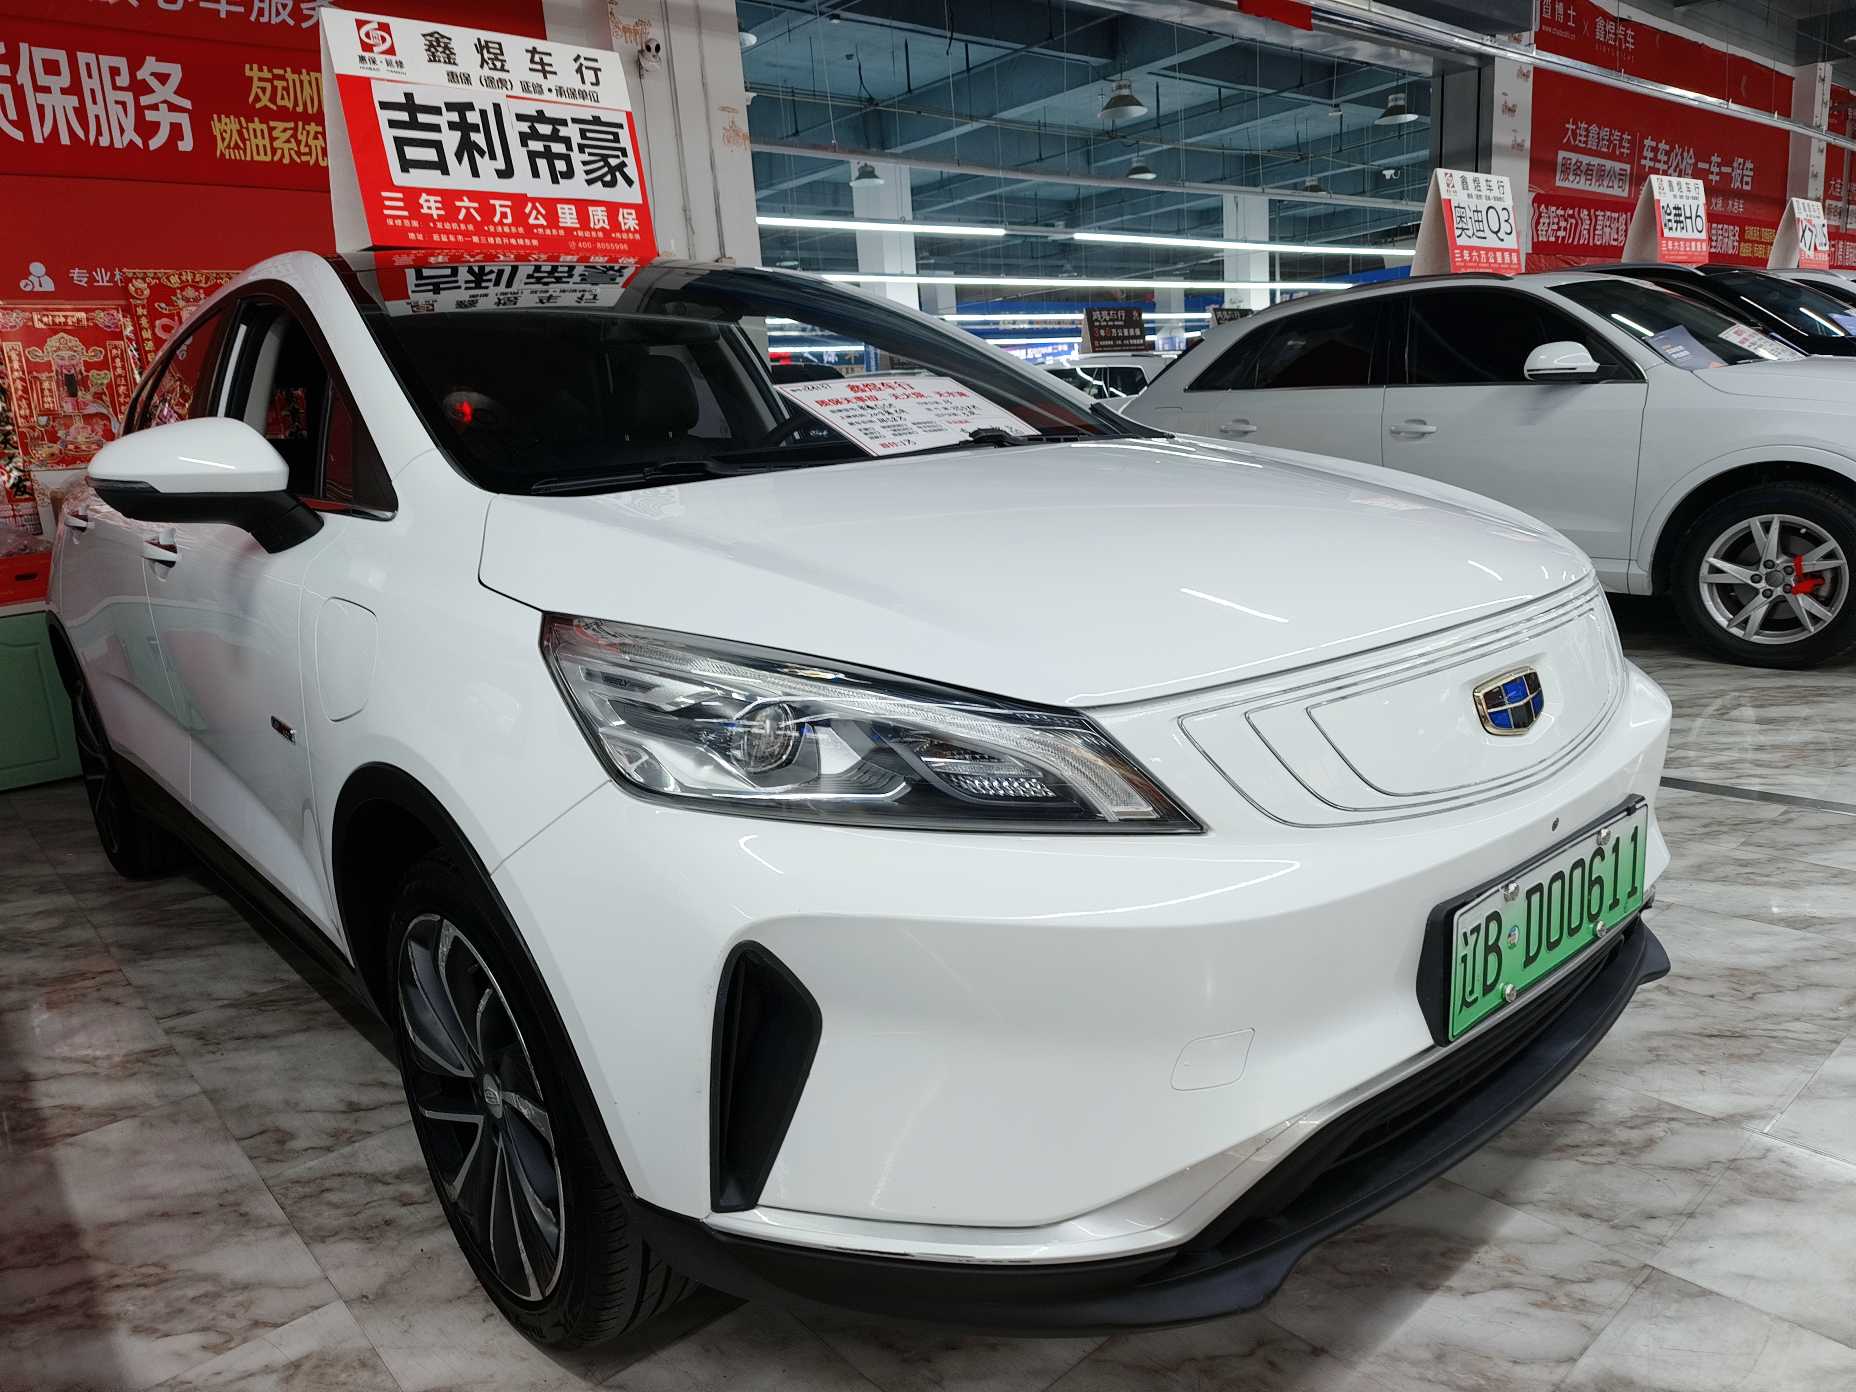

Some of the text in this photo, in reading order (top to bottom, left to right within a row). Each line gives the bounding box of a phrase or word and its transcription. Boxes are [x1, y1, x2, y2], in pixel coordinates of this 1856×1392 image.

[421, 30, 602, 87] 鑫煜车行
[211, 113, 329, 168] 燃油系统
[377, 91, 636, 190] 吉利帝豪
[1562, 119, 1633, 158] 大连鑫煜汽车
[1558, 156, 1630, 193] 服务有限公司
[380, 191, 640, 231] 三年六万公里质保
[1453, 202, 1514, 242] 奥迪Q3
[1661, 203, 1705, 234] 哈弗H6
